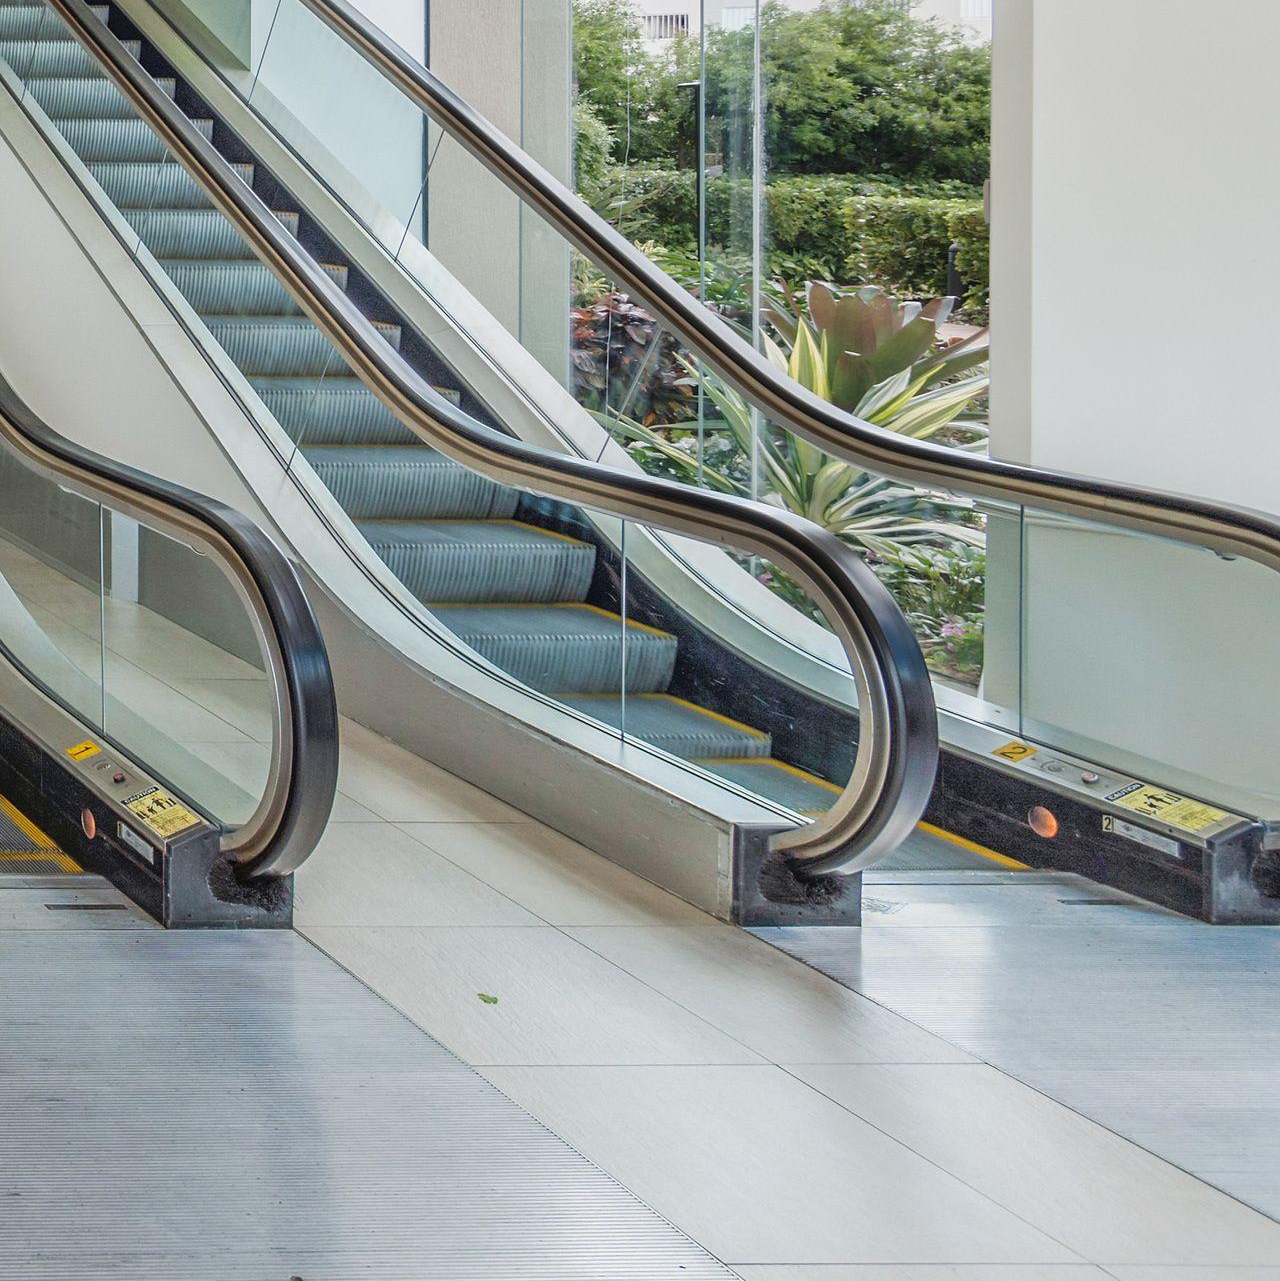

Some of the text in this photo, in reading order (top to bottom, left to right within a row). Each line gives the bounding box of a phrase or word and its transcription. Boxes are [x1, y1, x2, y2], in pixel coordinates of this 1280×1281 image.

[1000, 746, 1028, 759] 2
[123, 786, 158, 806] CAUTION
[1107, 782, 1142, 801] CAUTION
[1104, 816, 1111, 830] 2
